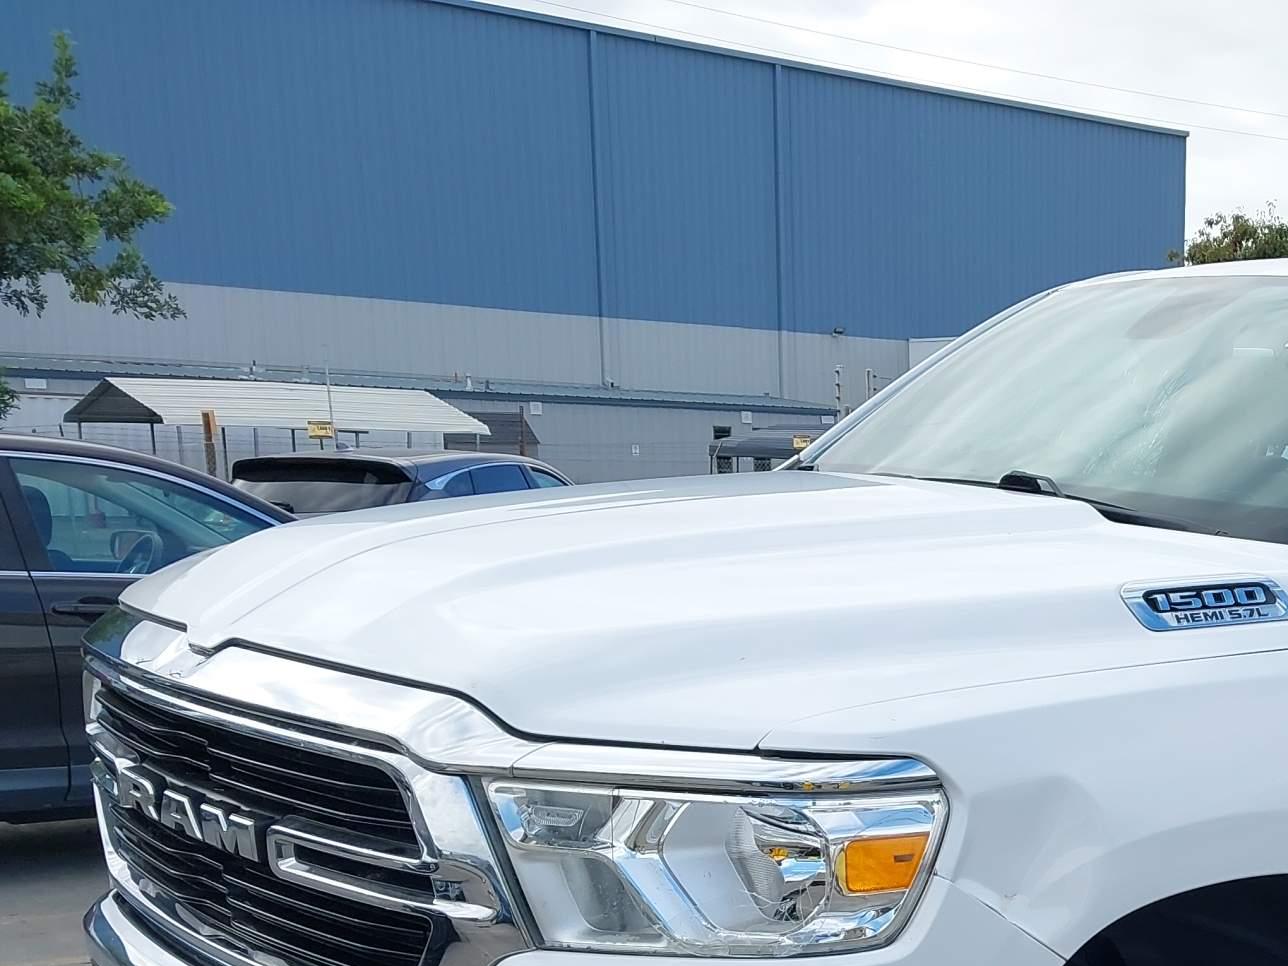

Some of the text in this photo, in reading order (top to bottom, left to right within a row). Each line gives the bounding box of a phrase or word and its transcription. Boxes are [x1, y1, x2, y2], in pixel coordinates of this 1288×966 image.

[1150, 587, 1267, 611] 1500
[1175, 607, 1269, 624] HEMI 5.7L
[118, 764, 259, 862] RAM
